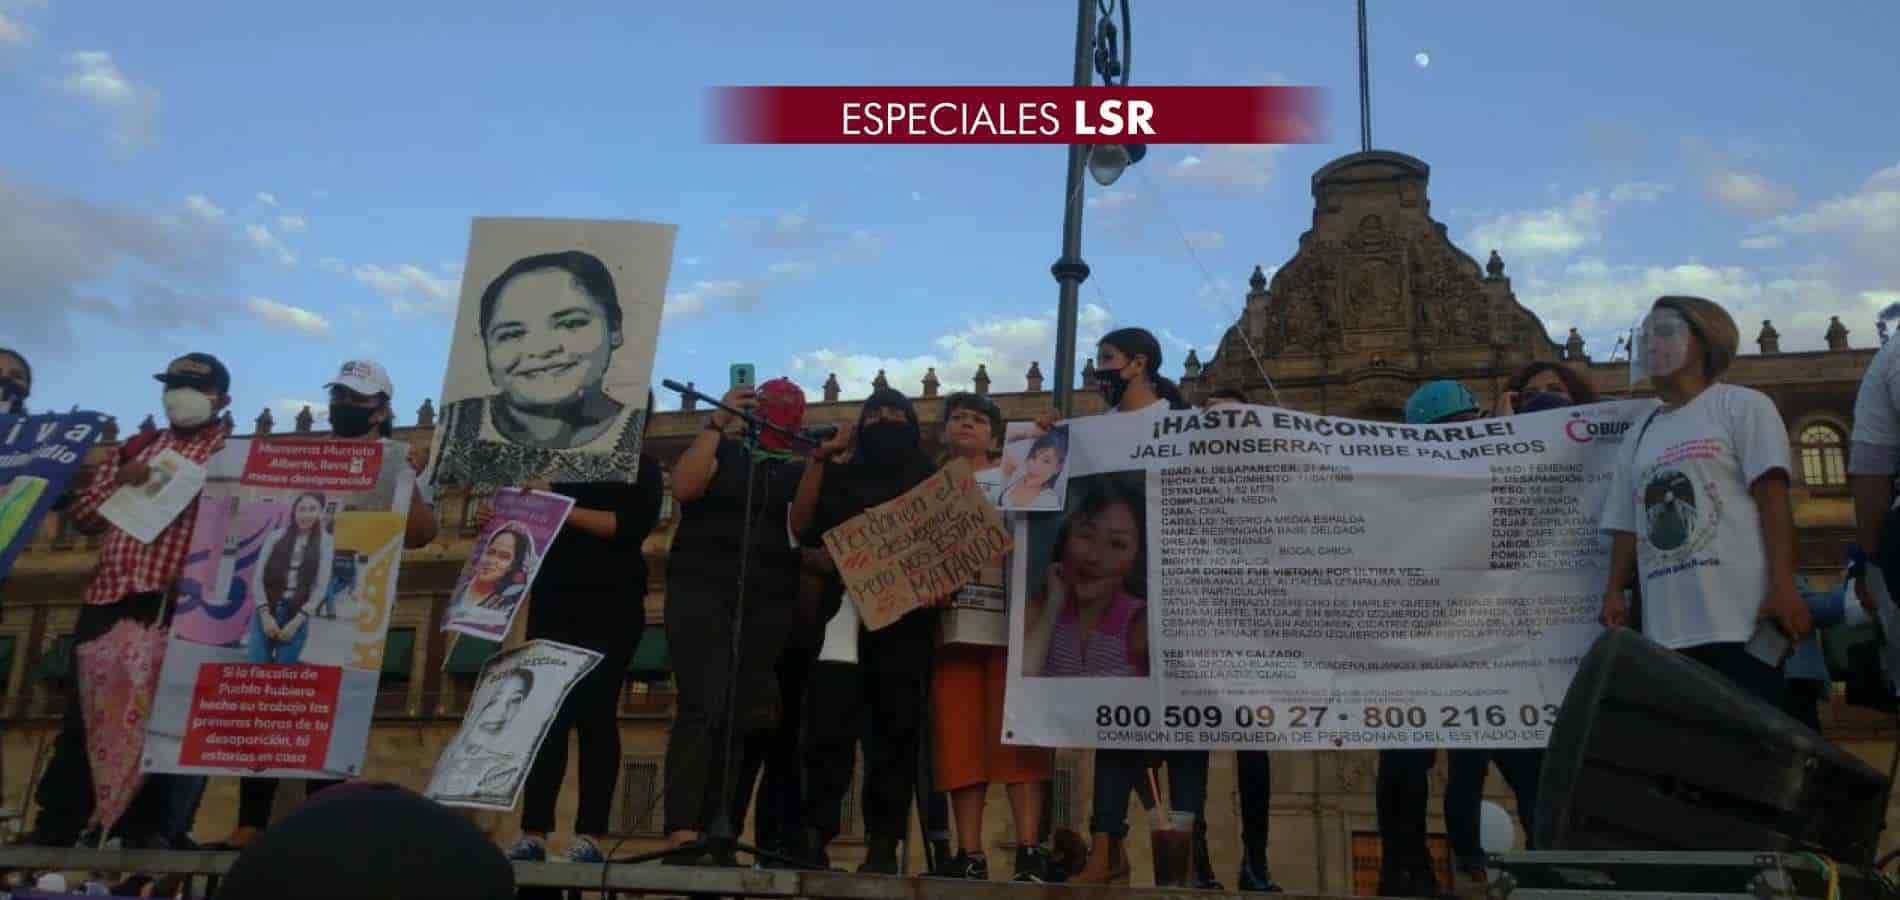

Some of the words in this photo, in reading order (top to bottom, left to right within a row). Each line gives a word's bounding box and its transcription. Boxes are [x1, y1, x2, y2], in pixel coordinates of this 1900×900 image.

[1153, 409, 1262, 439] ¡HASTA
[1273, 413, 1516, 443] ENCONTRARLE!
[1565, 418, 1632, 443] COBUP
[1130, 443, 1184, 459] JAEL
[1189, 438, 1332, 457] MONSERRAT
[1339, 443, 1409, 459] URIBE
[1417, 439, 1546, 461] PALMEROS
[299, 669, 318, 682] de
[294, 718, 313, 731] de
[1096, 704, 1151, 728] 800
[1164, 704, 1223, 728] 509
[1234, 704, 1276, 728] 09
[1288, 704, 1329, 728] 27
[1363, 703, 1427, 728] 800
[1439, 704, 1506, 728] 216
[1174, 730, 1195, 743] DE
[1291, 731, 1314, 743] DE
[1413, 730, 1440, 743] DEL
[1448, 730, 1514, 743] ESTADO
